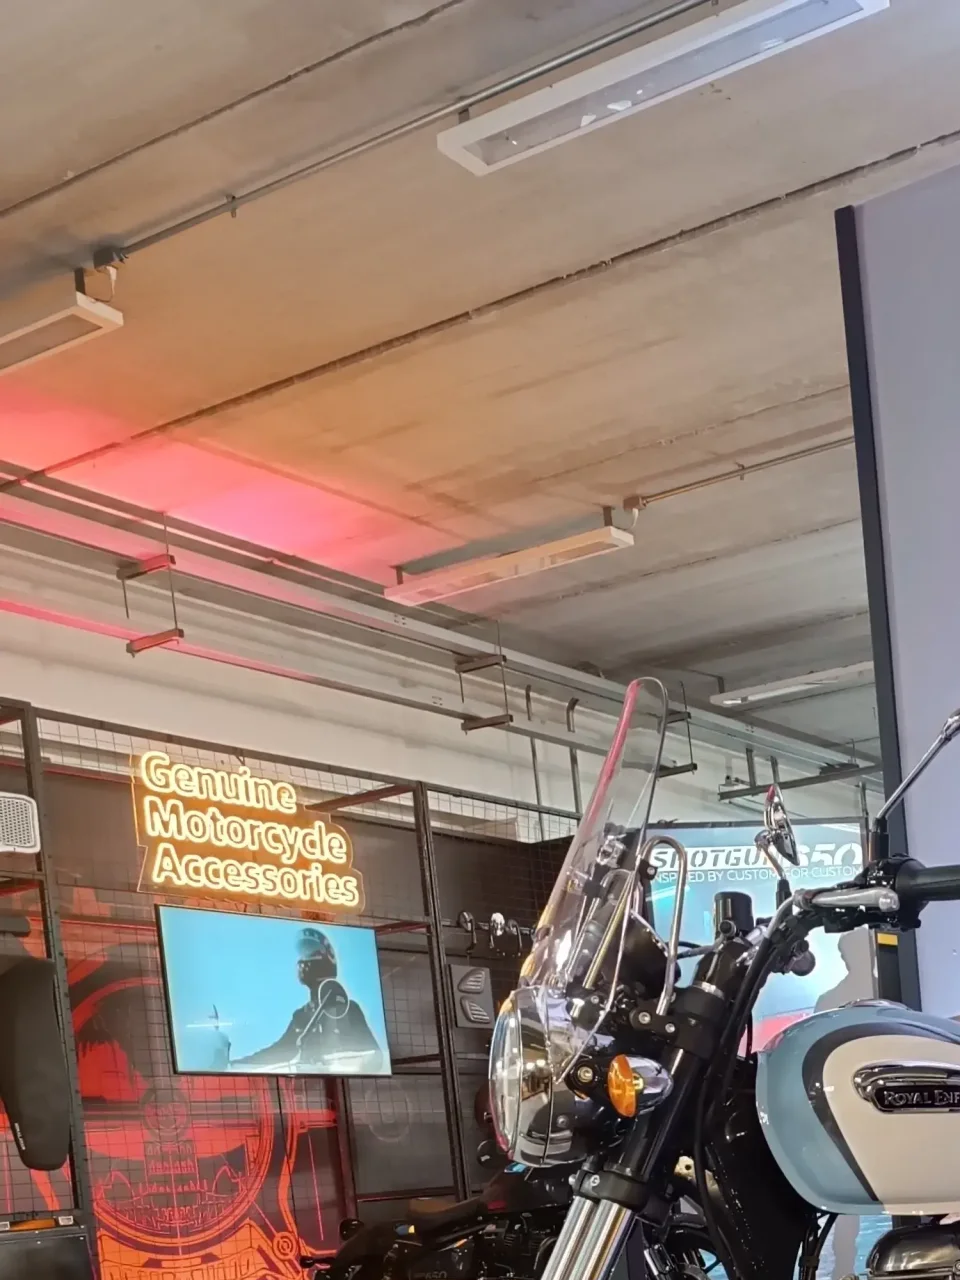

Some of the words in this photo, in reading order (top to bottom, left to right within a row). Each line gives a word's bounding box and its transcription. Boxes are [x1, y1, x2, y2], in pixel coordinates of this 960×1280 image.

[140, 750, 297, 814] Genuine
[144, 796, 348, 865] Motorcycle
[152, 842, 360, 907] Accessories
[651, 870, 705, 884] NSPED
[707, 870, 725, 882] BY
[884, 1090, 932, 1106] ROYAL
